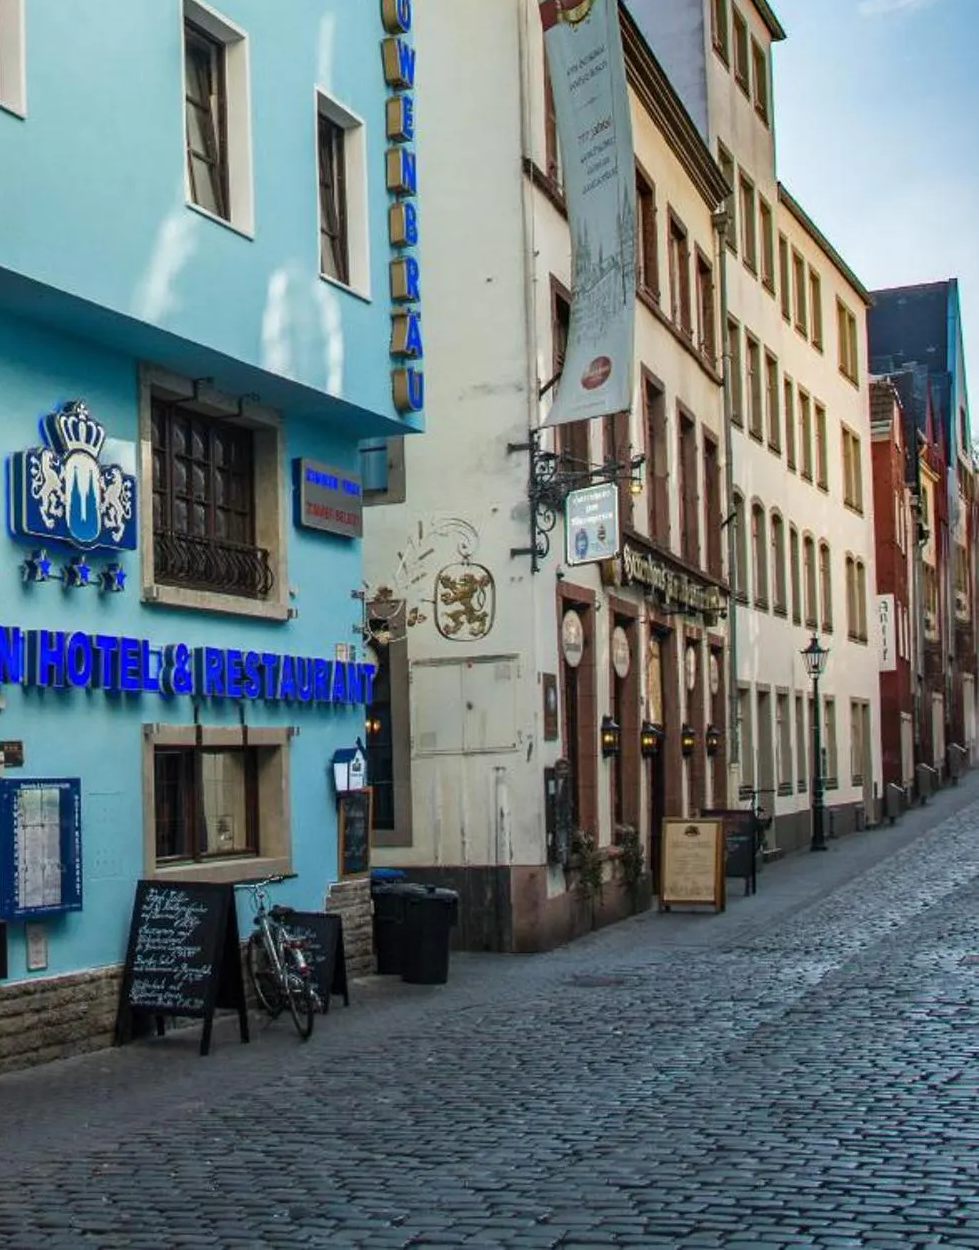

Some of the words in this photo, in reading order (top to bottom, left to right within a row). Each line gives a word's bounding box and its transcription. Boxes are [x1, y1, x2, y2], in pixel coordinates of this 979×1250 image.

[35, 630, 160, 693] HOTEL
[168, 643, 193, 694] &
[201, 646, 376, 705] RESTAURANT
